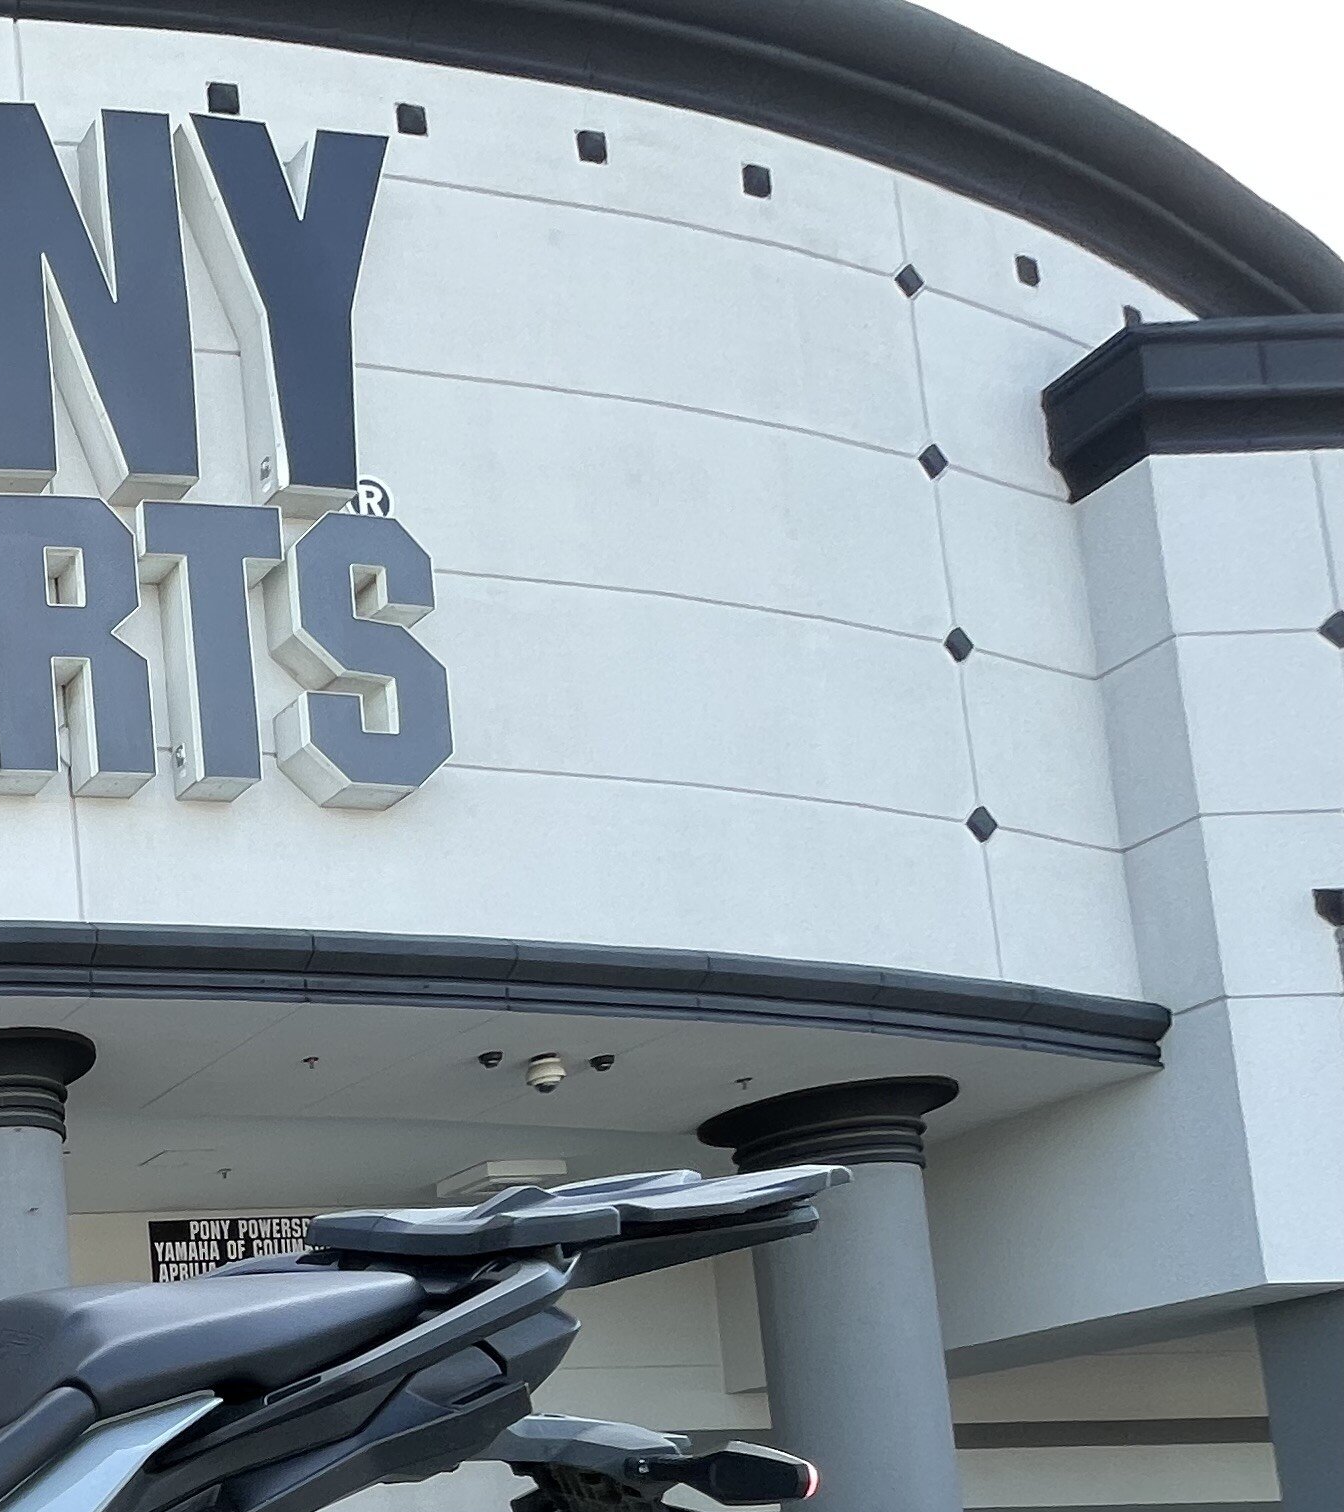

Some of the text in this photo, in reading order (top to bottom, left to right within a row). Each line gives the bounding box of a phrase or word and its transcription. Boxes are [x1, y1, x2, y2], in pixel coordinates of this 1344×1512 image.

[189, 1220, 230, 1240] PONY
[154, 1242, 220, 1262] YAMAHA
[227, 1241, 245, 1260] OF
